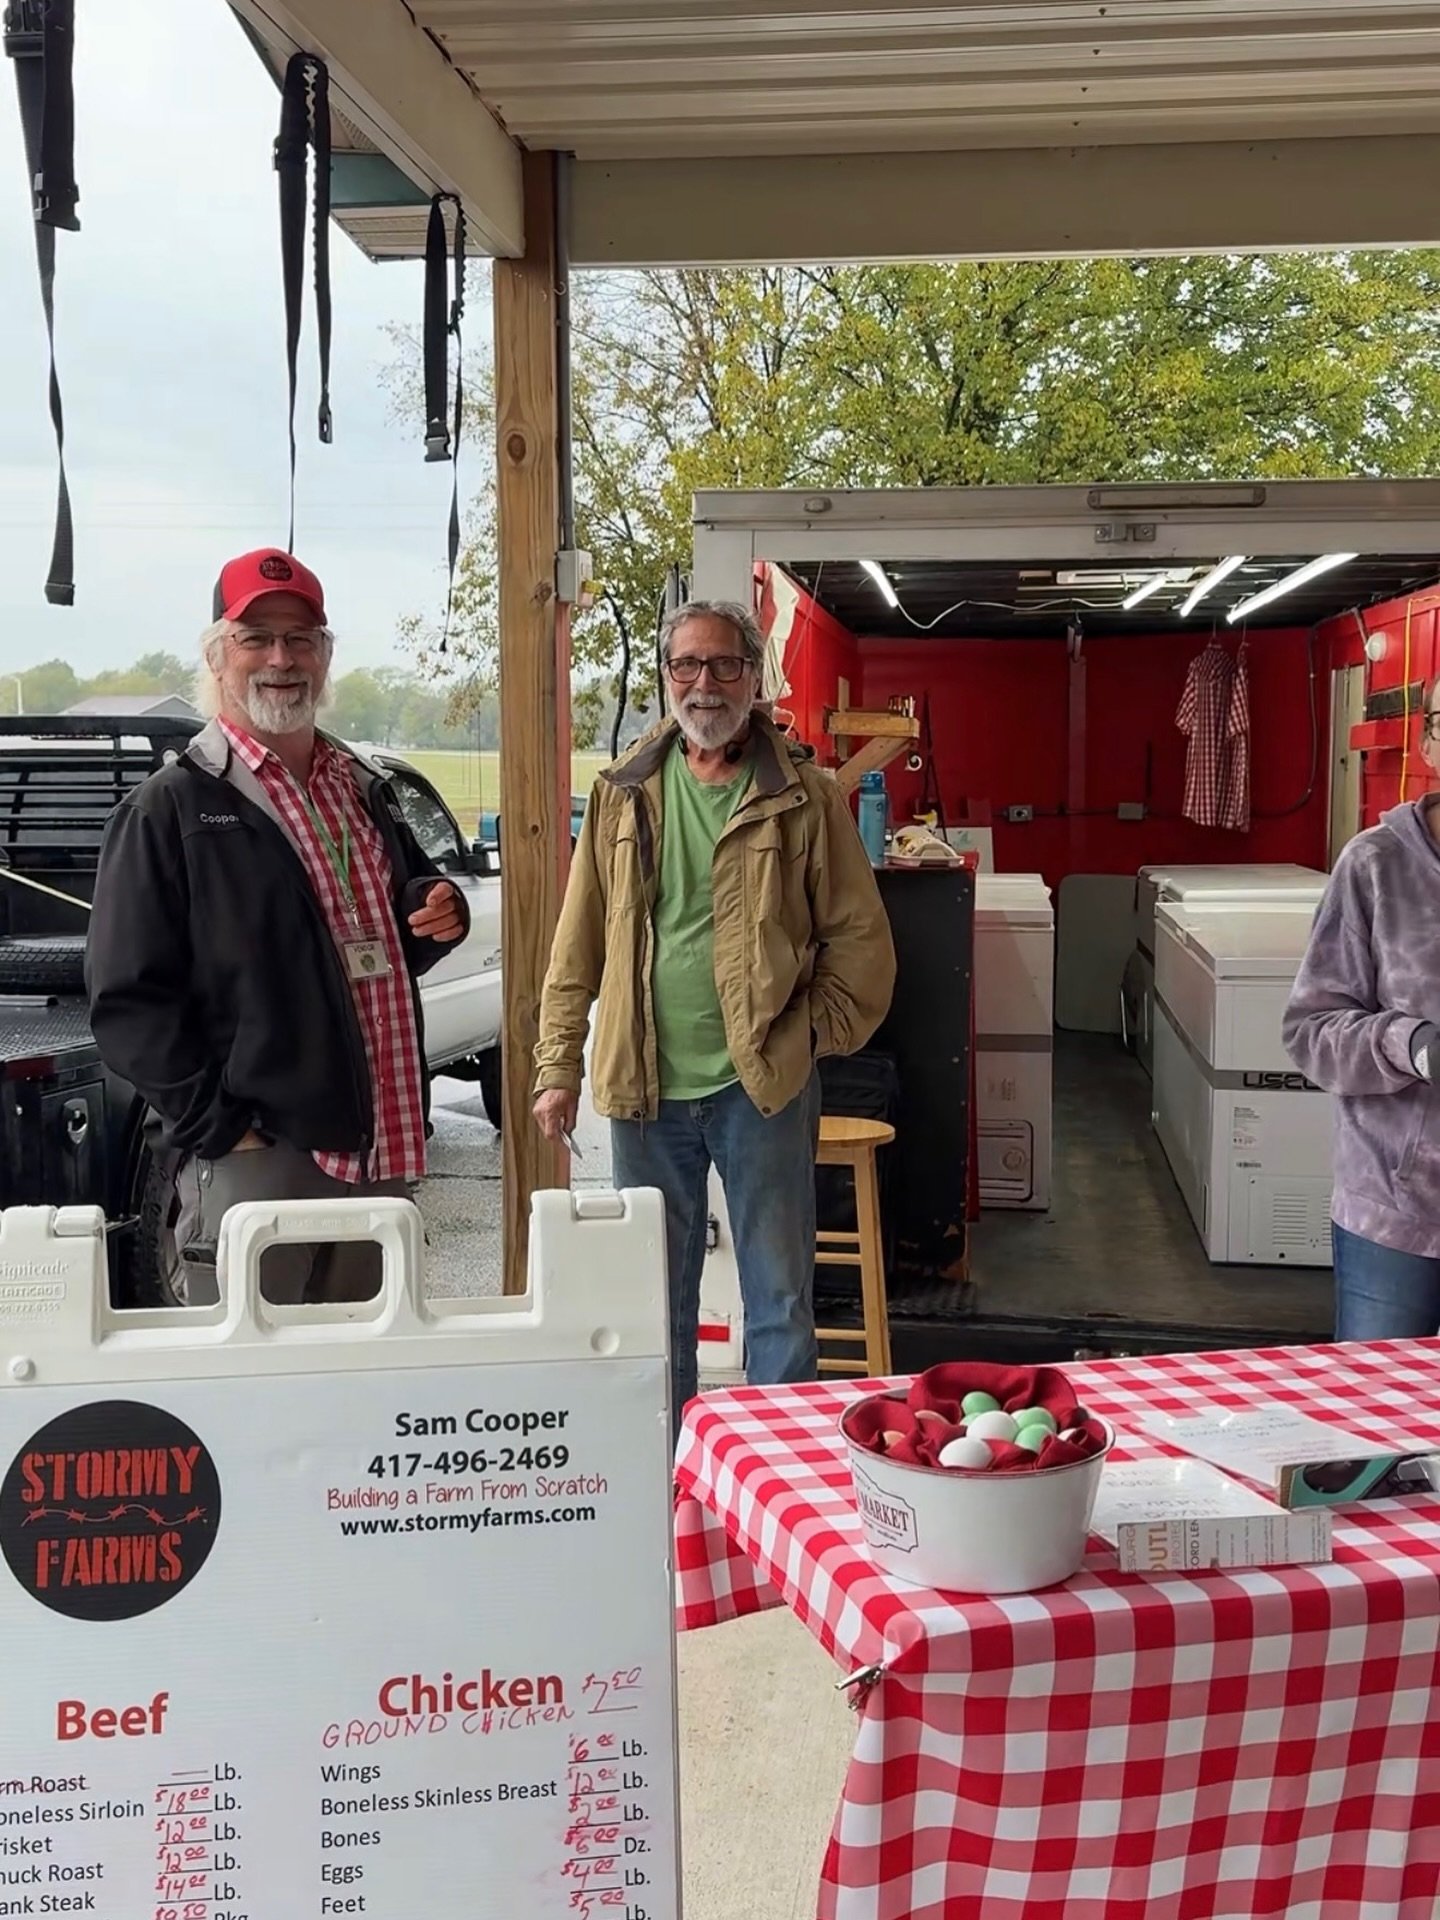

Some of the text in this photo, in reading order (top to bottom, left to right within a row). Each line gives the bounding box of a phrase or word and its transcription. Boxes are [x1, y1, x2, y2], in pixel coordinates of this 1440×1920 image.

[395, 1408, 570, 1437] Sam Cooper
[21, 1445, 201, 1503] STORMY
[368, 1444, 570, 1478] 417-496-2469
[327, 1473, 608, 1511] Building a Farm From Scratch
[340, 1503, 596, 1536] www.stormyfarms.com
[36, 1531, 183, 1588] FARMS
[378, 1668, 565, 1717] Chicken
[56, 1691, 169, 1741] Beef
[322, 1713, 448, 1749] GROUND
[31, 1774, 87, 1794] Roast
[214, 1762, 242, 1781] Lb.
[321, 1764, 381, 1784] Wings
[622, 1738, 648, 1757] Lb.
[79, 1800, 145, 1821] Sirloin
[214, 1792, 242, 1811] Lb.
[321, 1793, 409, 1816] Boneless
[414, 1786, 493, 1808] Skinless
[498, 1779, 558, 1801] Breast
[623, 1771, 649, 1790] Lb.
[214, 1822, 242, 1841] Lb.
[321, 1829, 381, 1849] Bones
[624, 1803, 650, 1822] Lb.
[48, 1862, 104, 1882] Roast
[214, 1852, 242, 1871] Lb.
[321, 1863, 364, 1885] Eggs
[624, 1836, 652, 1854] Dz.
[0, 1895, 35, 1915] ank
[40, 1891, 96, 1913] Steak
[214, 1882, 242, 1901] Lb.
[321, 1895, 366, 1914] Feet
[625, 1867, 651, 1887] Lb.
